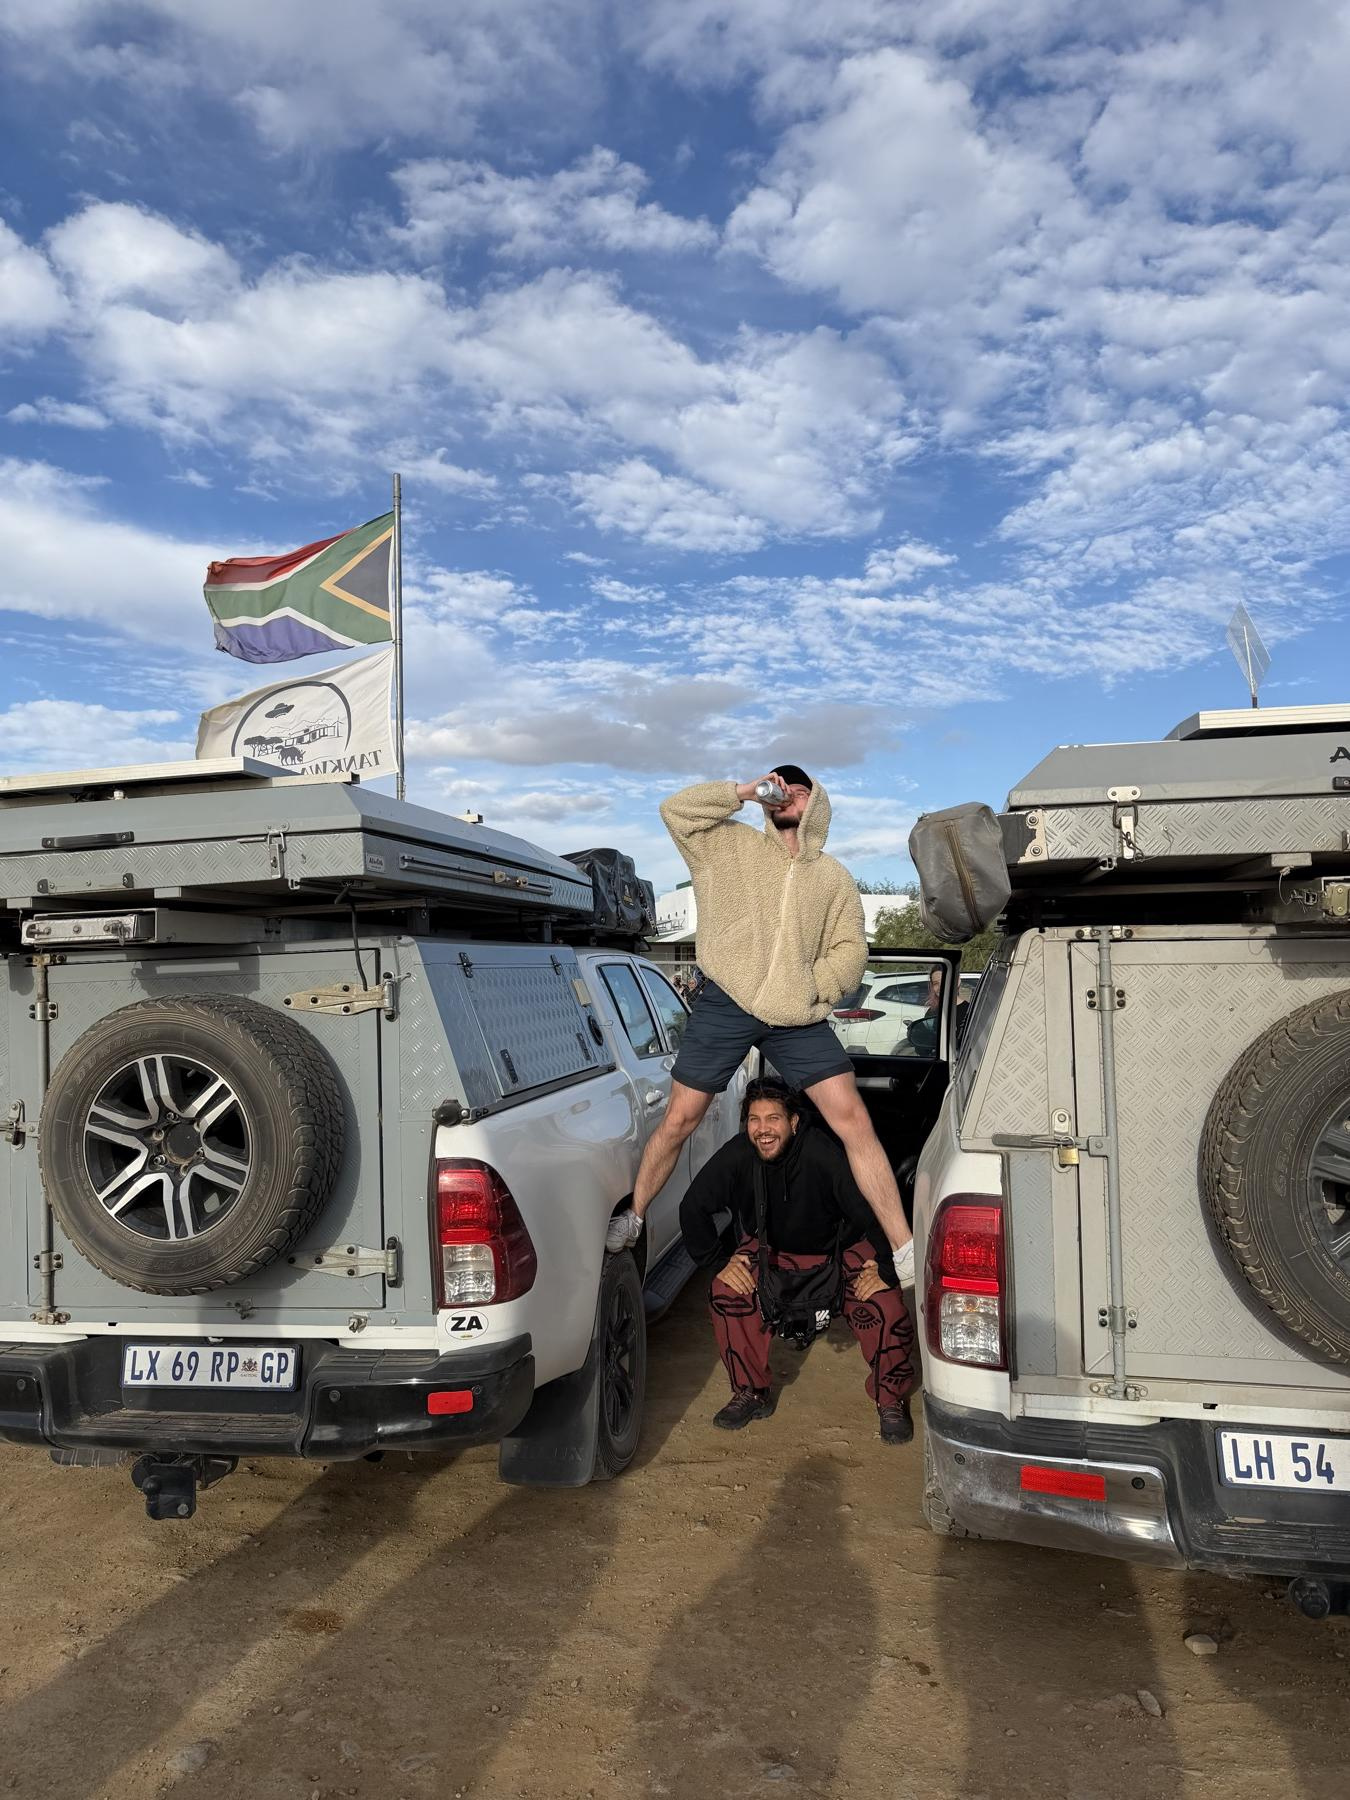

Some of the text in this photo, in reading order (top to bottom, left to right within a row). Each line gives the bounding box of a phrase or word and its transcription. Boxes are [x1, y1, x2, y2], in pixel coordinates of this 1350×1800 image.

[451, 1315, 483, 1331] ZA
[129, 1350, 289, 1383] LX 69 RP GP
[1231, 1438, 1335, 1484] LH 54
